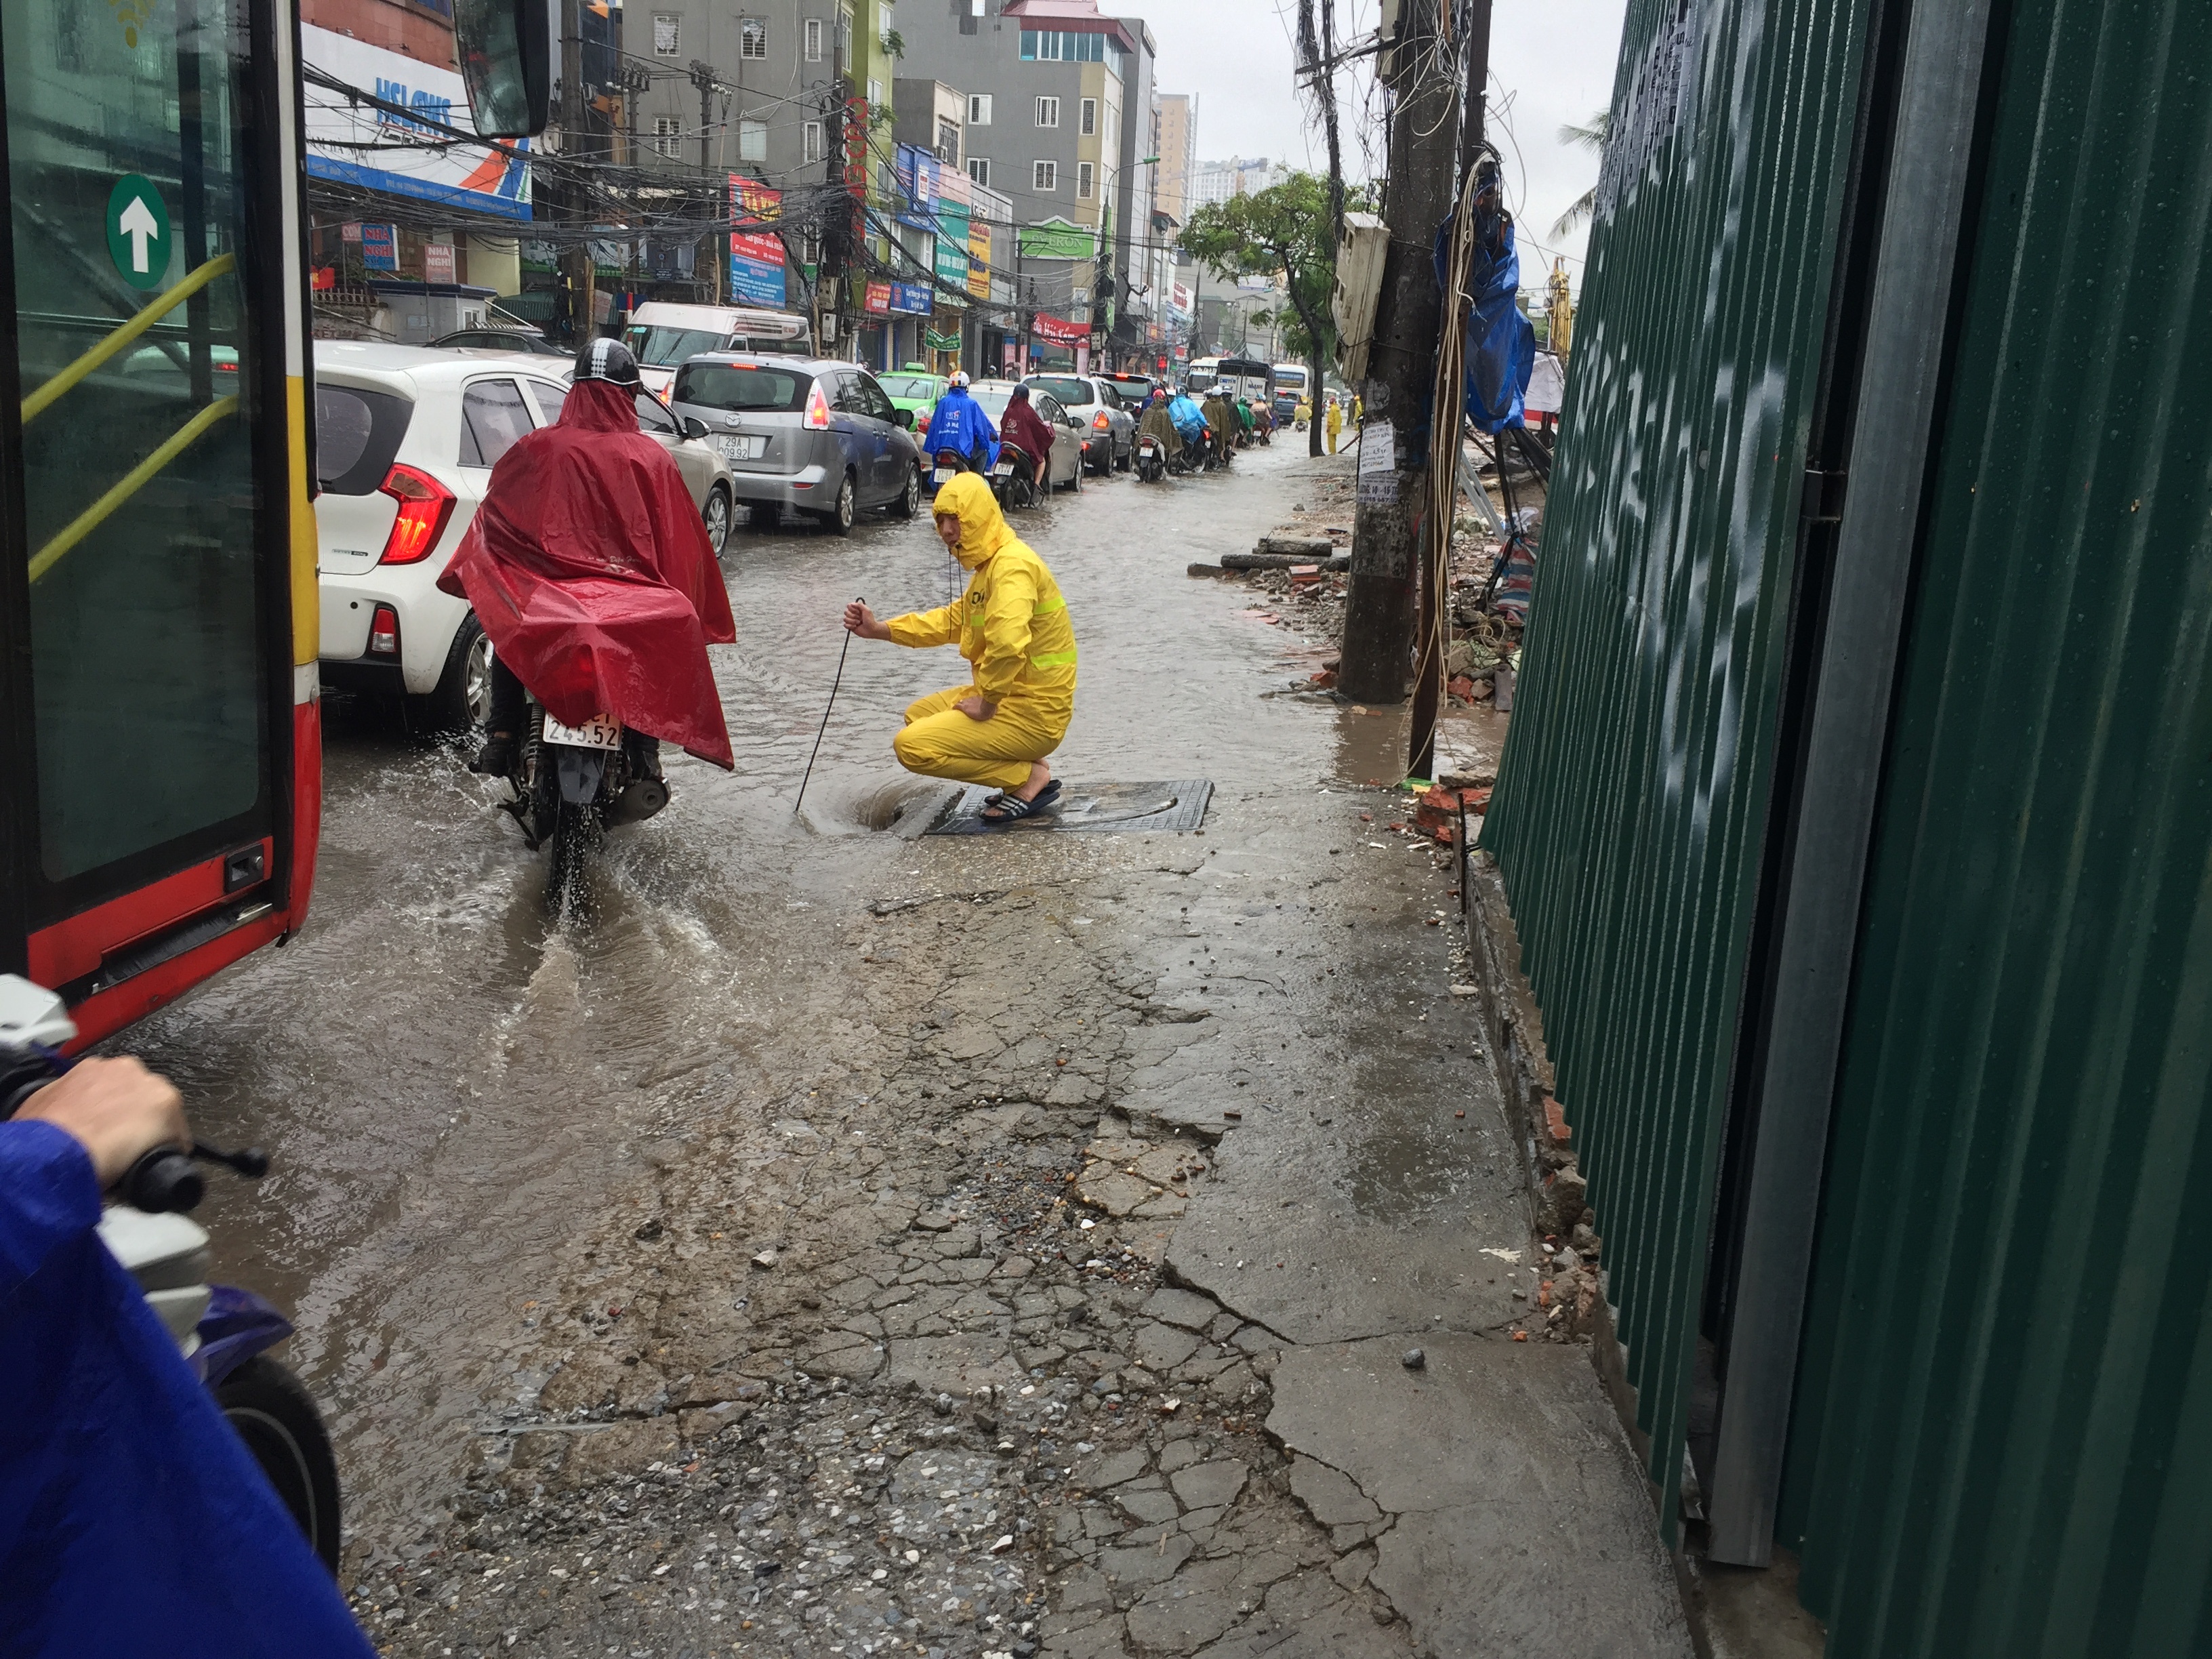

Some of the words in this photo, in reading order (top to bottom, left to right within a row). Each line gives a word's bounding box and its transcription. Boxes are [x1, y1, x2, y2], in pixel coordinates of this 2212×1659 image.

[1031, 232, 1082, 249] EVERON
[428, 245, 450, 255] NHÀ
[726, 437, 741, 447] 29A
[550, 720, 617, 747] 245.52
